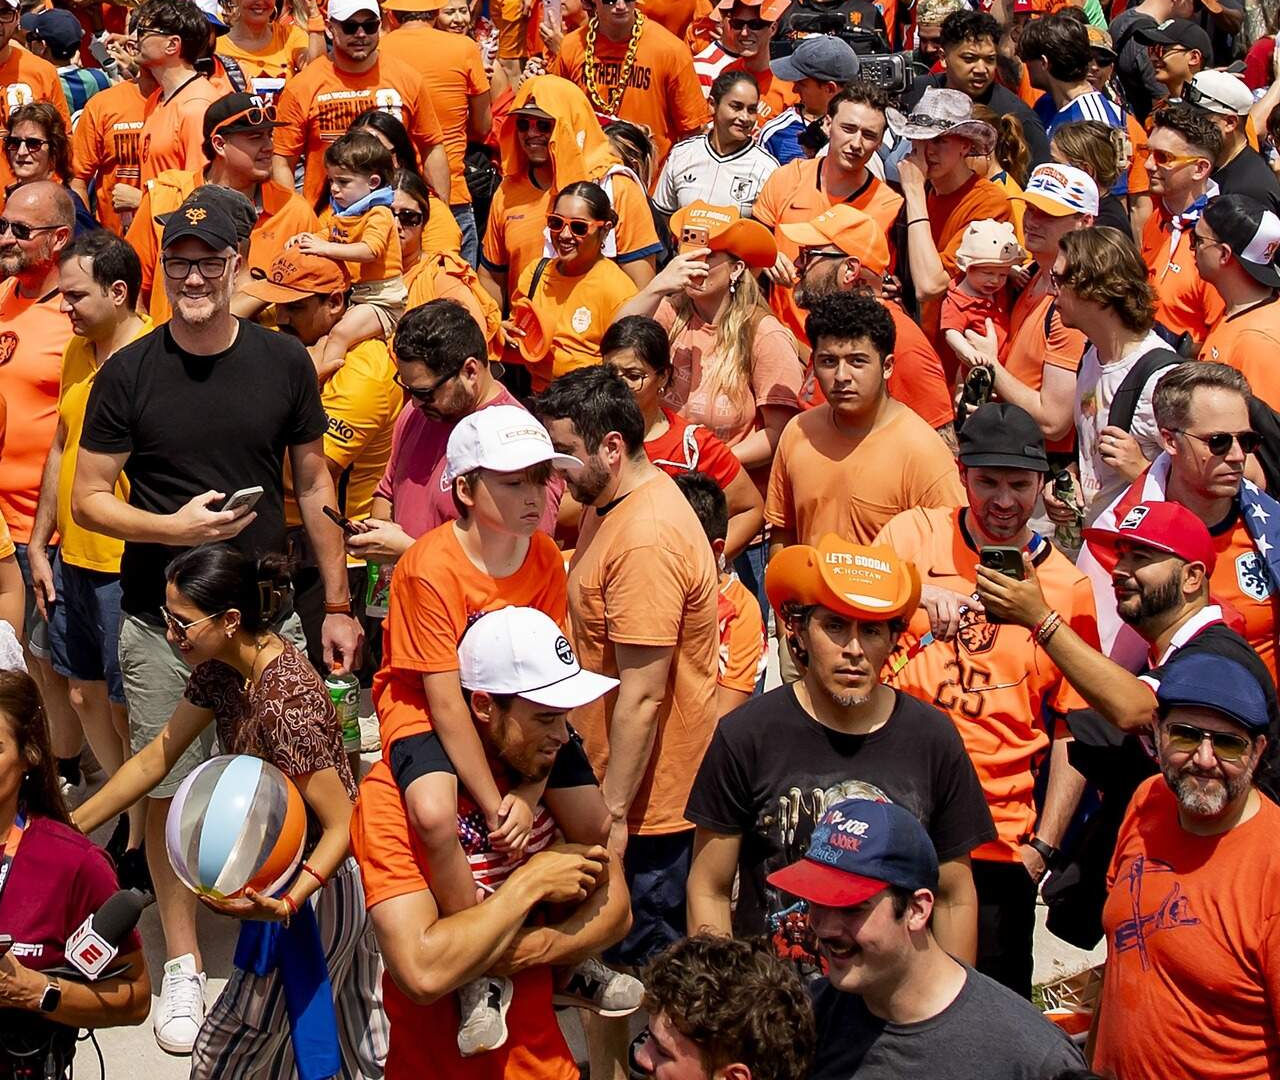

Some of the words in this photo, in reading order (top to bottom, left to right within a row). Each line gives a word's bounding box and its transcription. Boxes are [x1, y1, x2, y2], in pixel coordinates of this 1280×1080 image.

[317, 93, 332, 102] FIFA
[332, 91, 356, 100] WORLD
[357, 89, 373, 98] CUP
[113, 122, 130, 131] FIFA
[329, 417, 354, 441] eko
[825, 551, 854, 566] LET'S
